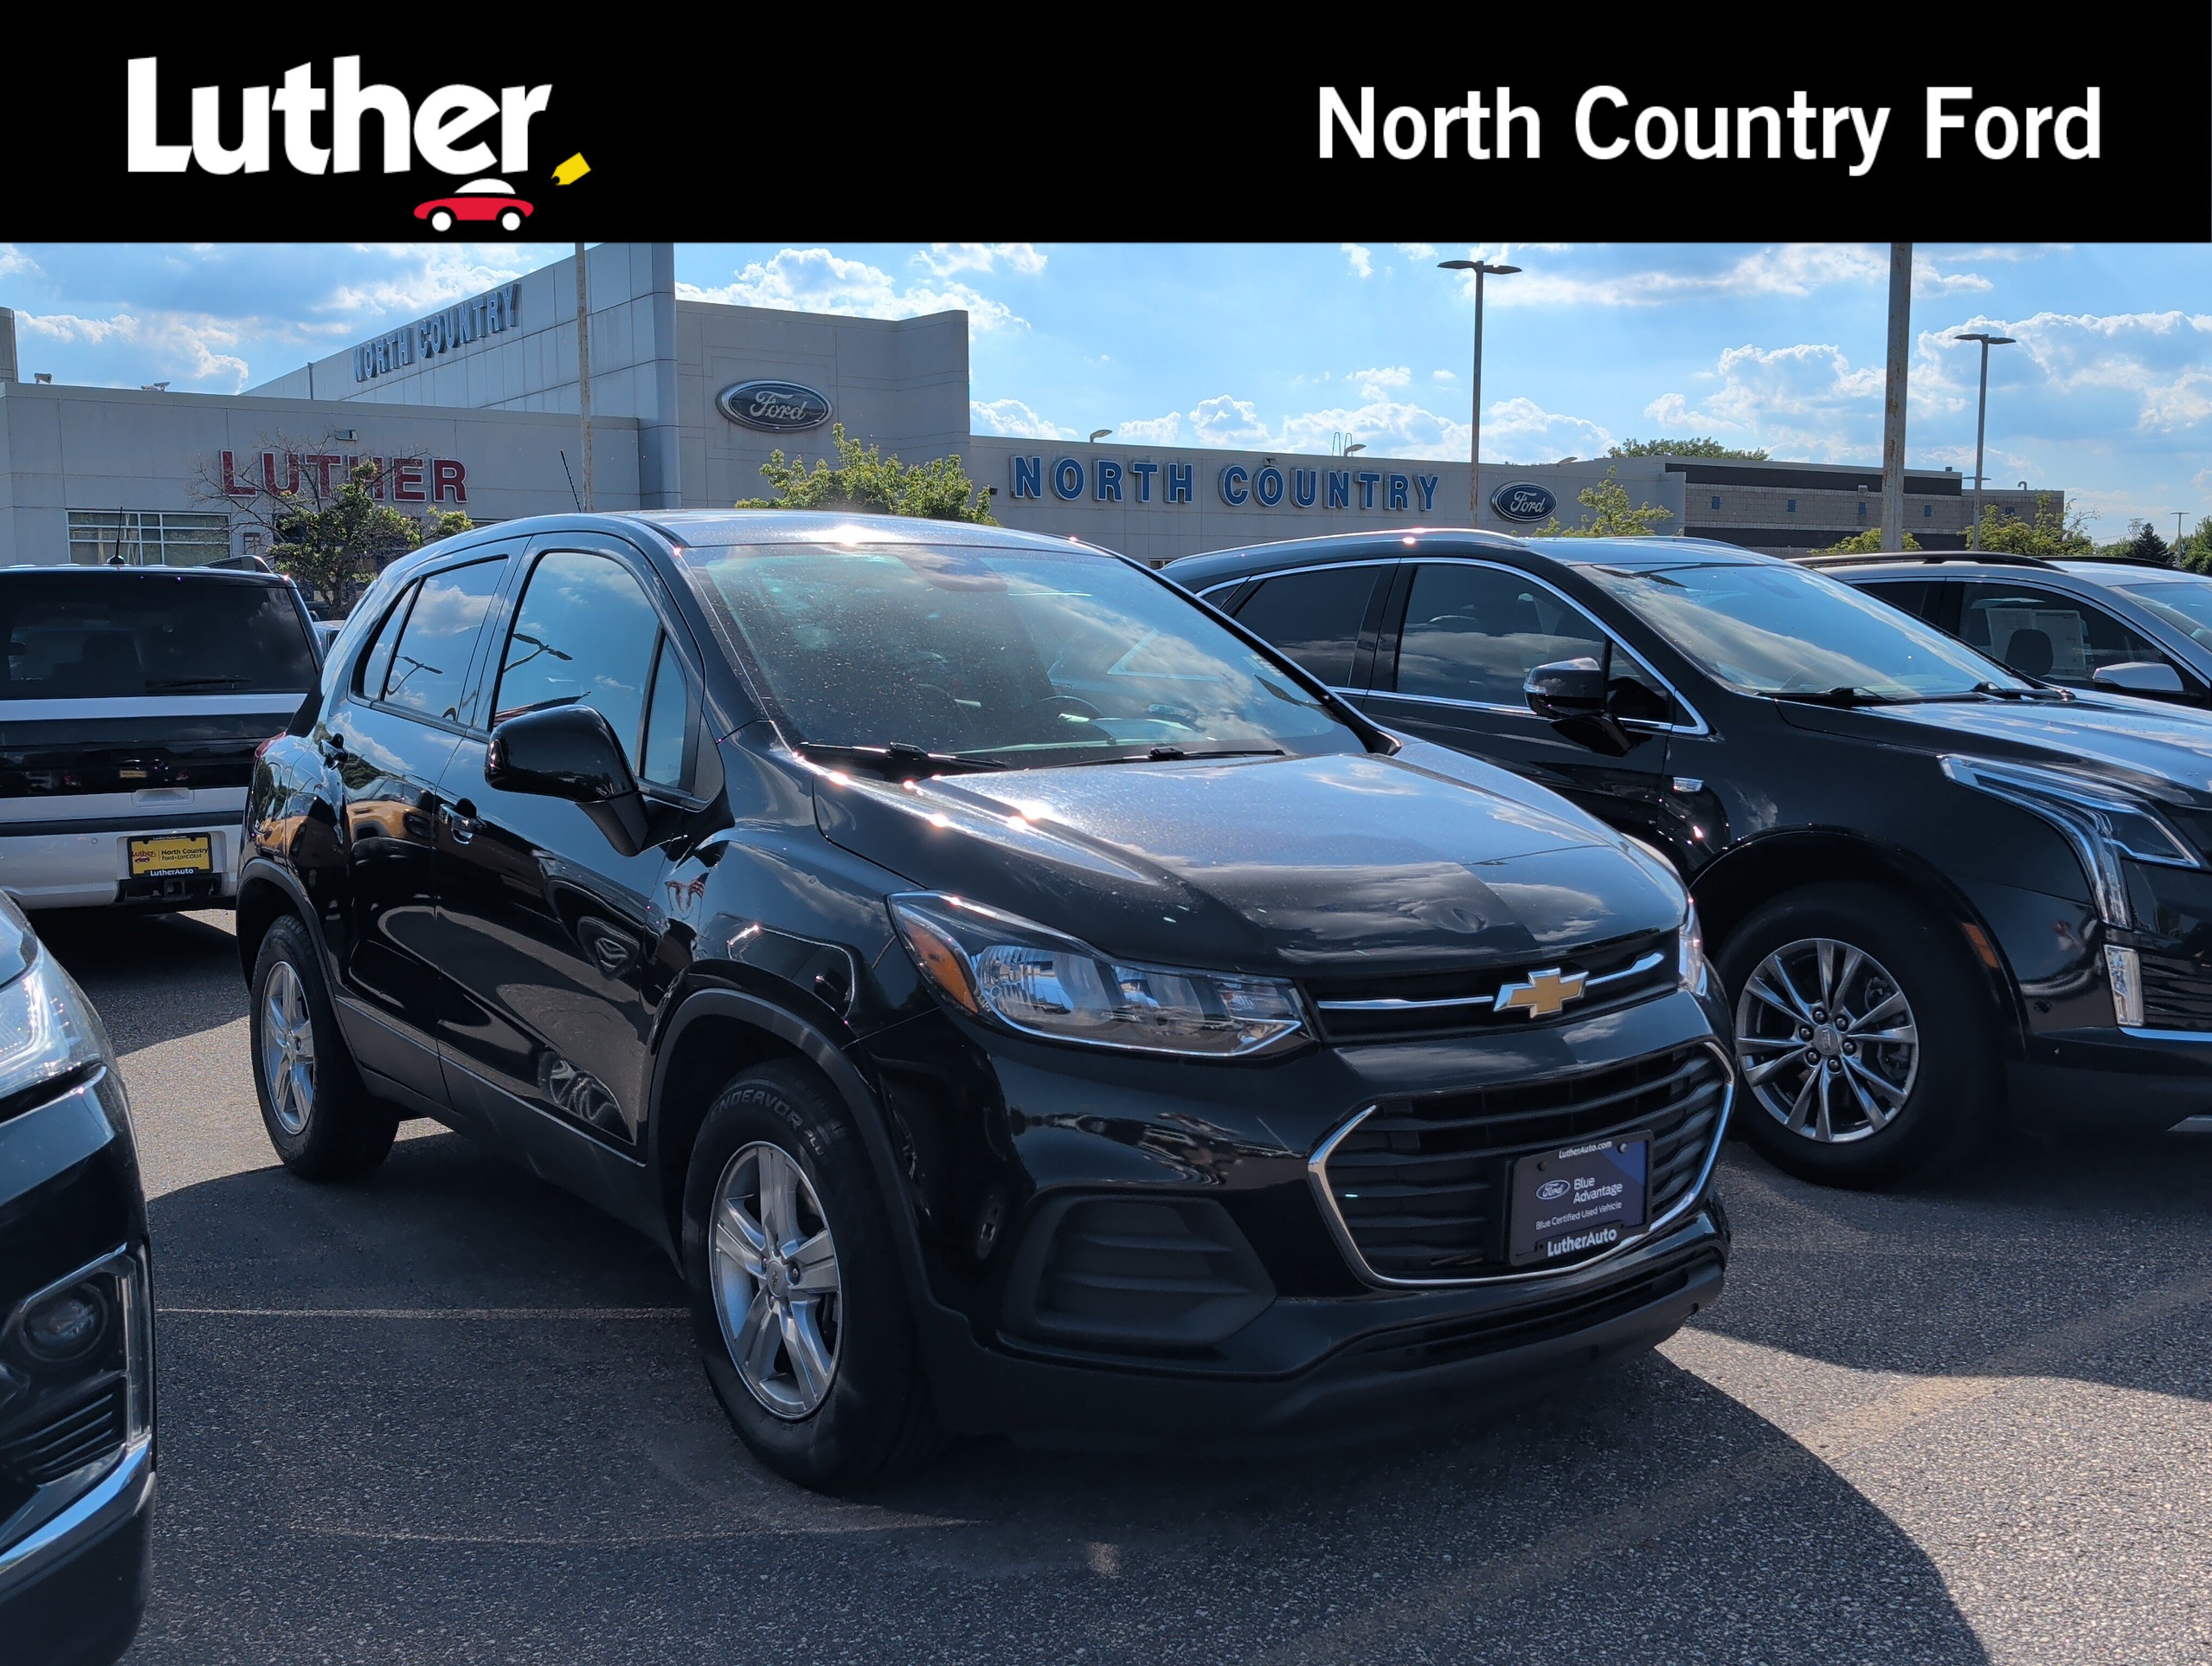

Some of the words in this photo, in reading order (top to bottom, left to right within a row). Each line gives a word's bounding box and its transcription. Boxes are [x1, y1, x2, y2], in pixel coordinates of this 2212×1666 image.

[353, 328, 413, 382] NORTH
[417, 284, 520, 358] COUNTRY
[749, 390, 808, 421] Ford
[1012, 455, 1193, 503] NORTH
[1219, 464, 1440, 511] COUNTRY
[1510, 490, 1546, 513] Ford
[150, 868, 194, 877] LutherAuto
[710, 1088, 803, 1132] ENDEAVOR
[1558, 1140, 1613, 1159] LutherAuto.com
[1573, 1177, 1596, 1190] Blue
[1573, 1182, 1623, 1204] Advantage
[1535, 1219, 1551, 1230] Blue
[1551, 1210, 1581, 1226] Certified
[1581, 1206, 1598, 1219] Used
[1598, 1201, 1623, 1214] Vehicle
[1547, 1228, 1617, 1257] LutherAuto
